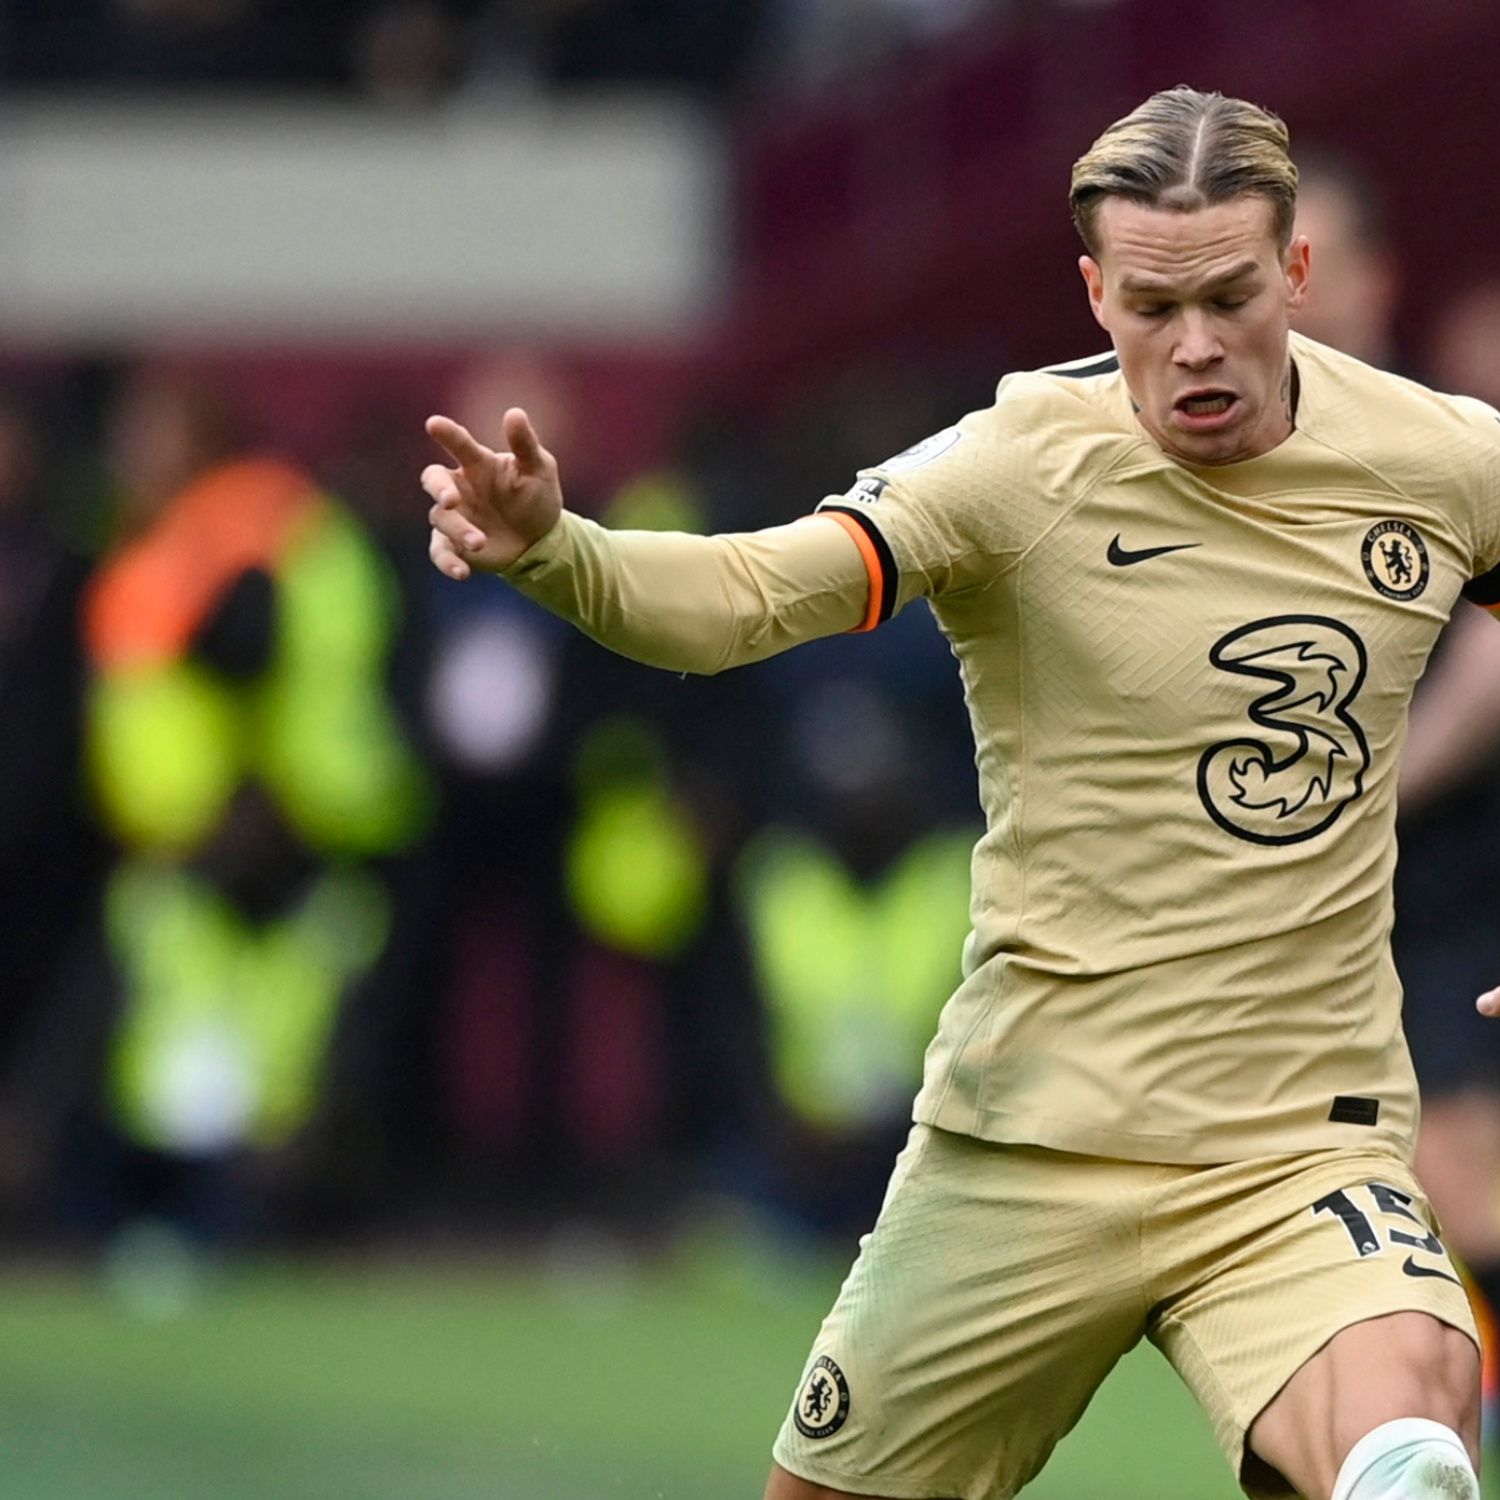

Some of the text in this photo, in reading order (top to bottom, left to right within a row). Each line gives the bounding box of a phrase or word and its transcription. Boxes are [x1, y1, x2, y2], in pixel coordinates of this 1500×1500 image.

[1367, 522, 1412, 542] CHELSEA
[1197, 614, 1371, 847] 3
[1311, 1182, 1443, 1257] 15
